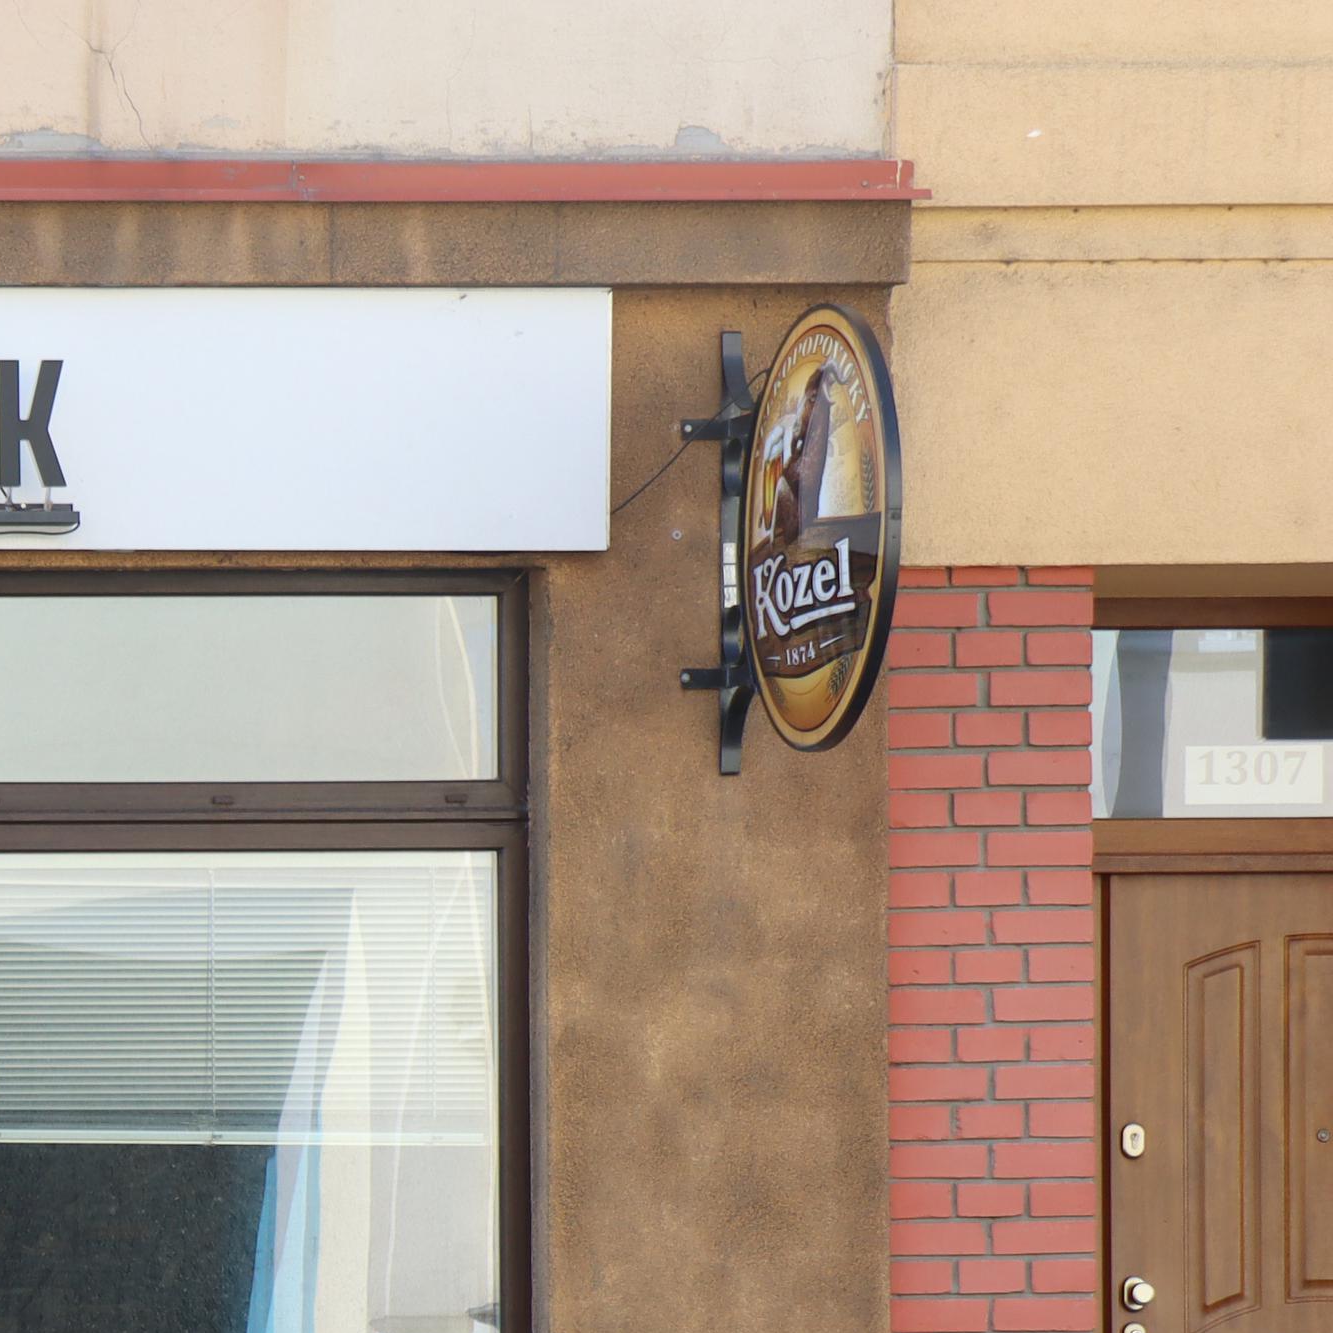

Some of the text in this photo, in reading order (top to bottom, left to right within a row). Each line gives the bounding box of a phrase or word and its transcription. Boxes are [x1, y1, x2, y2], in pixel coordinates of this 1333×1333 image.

[753, 536, 856, 641] Kozel
[785, 640, 817, 667] 1874
[1198, 750, 1308, 786] 1307
